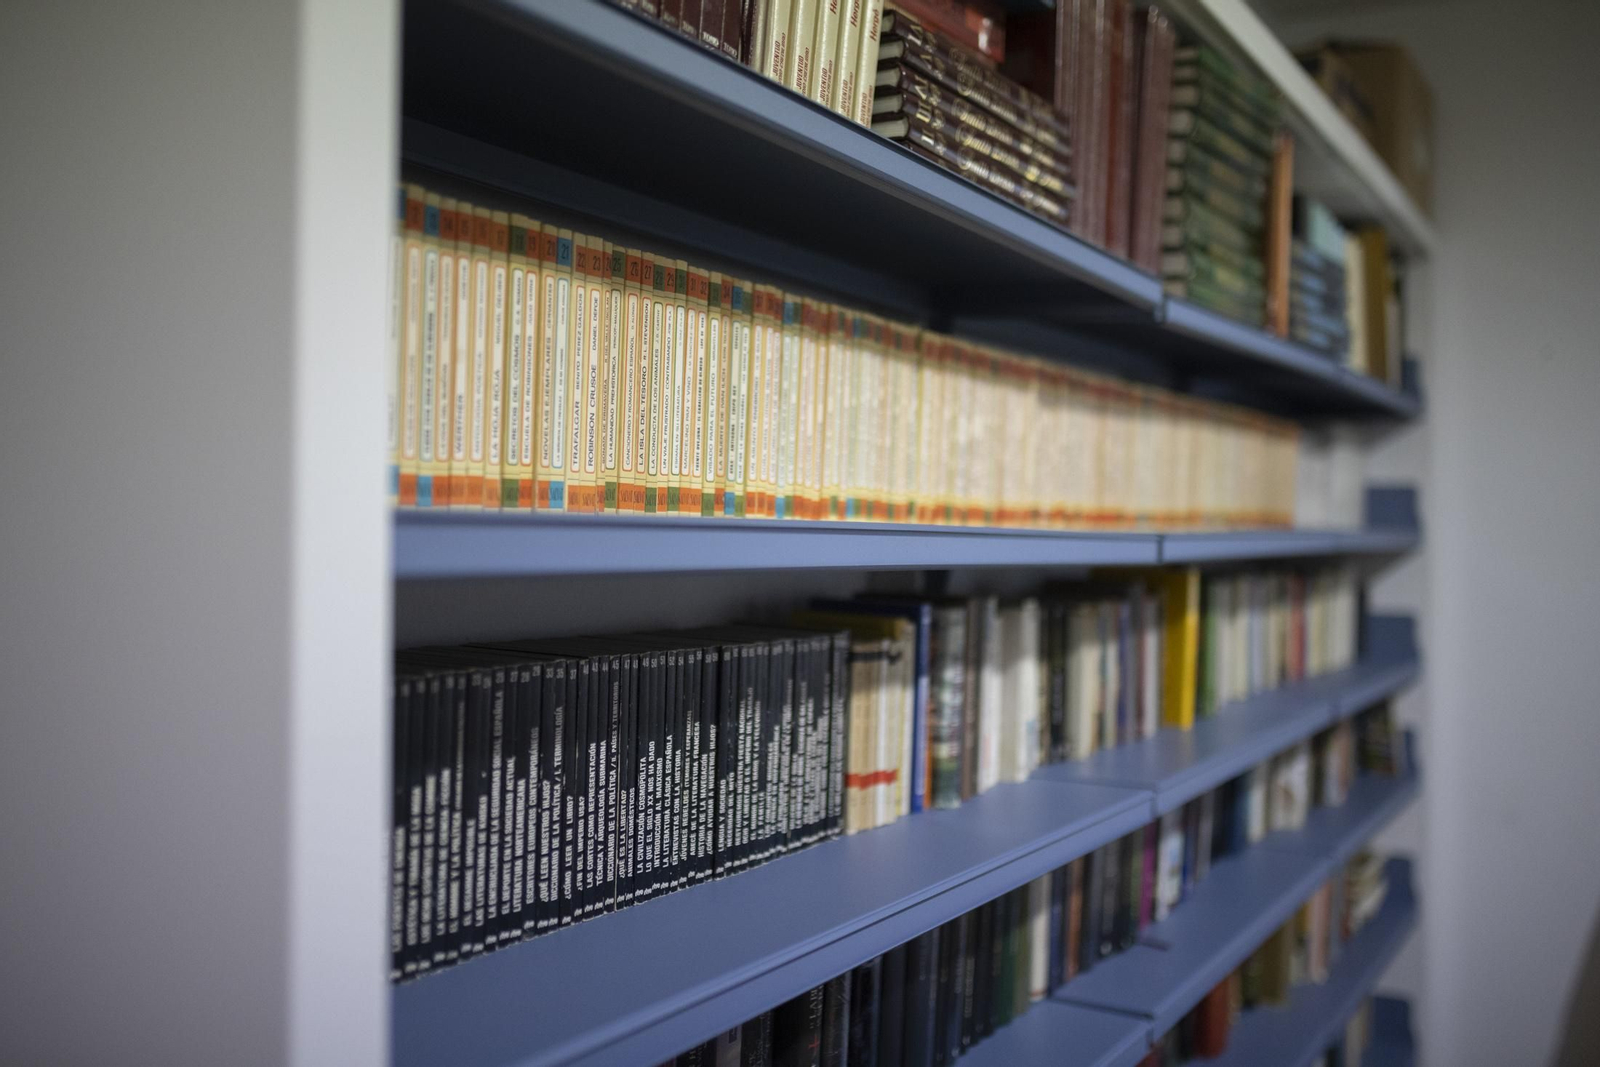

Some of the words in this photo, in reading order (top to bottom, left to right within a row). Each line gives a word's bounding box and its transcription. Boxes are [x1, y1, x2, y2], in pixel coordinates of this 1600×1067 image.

[664, 337, 672, 390] CONTRABANDO
[589, 364, 597, 408] CRUSOE
[664, 734, 673, 774] ESPAÑOLA
[692, 721, 700, 759] FRANCESA
[587, 742, 597, 812] REPRESENTACIÓN
[598, 740, 607, 786] SUBMARINA
[647, 763, 655, 775] HA
[674, 749, 682, 784] HISTORIA
[638, 756, 647, 811] COSMOPOLITA
[647, 776, 655, 792] NOS
[655, 757, 664, 799] MARXISMO
[663, 775, 672, 807] CLÁSICA
[673, 785, 681, 796] LA
[690, 760, 699, 807] LITERATURA
[540, 780, 551, 809] HIJOS?
[551, 784, 562, 821] POLÍTICA
[577, 795, 586, 817] USA?
[647, 794, 654, 806] XX
[655, 800, 663, 811] AL
[699, 799, 707, 811] LA
[719, 779, 727, 814] SOCIEDAD
[514, 778, 526, 857] NORTEAMERICANA
[565, 795, 574, 824] LIBRO?
[619, 790, 627, 831] LIBERTAD?
[646, 808, 654, 831] SIGLO
[690, 807, 698, 819] LA
[699, 812, 706, 823] DE
[707, 799, 715, 828] AYUDAR
[527, 807, 538, 851] EUROPEOS
[540, 810, 550, 855] NUESTROS
[551, 823, 561, 835] LA
[565, 829, 573, 841] UN
[577, 819, 585, 853] IMPERIO
[587, 814, 595, 838] COMO
[619, 833, 627, 845] LA
[636, 812, 646, 861] CIVILIZACIÓN
[646, 832, 653, 843] EL
[690, 820, 697, 831] DE
[718, 824, 726, 852] LENGUA
[502, 848, 513, 861] EN
[503, 835, 513, 847] LA
[551, 836, 561, 849] DE
[587, 839, 595, 870] CORTES
[618, 846, 627, 857] ES
[645, 844, 653, 861] QUE
[653, 813, 662, 868] INTRODUCCIÓN
[672, 815, 680, 866] ENTREVISTAS
[697, 824, 706, 858] HISTORIA
[539, 857, 550, 879] LEEN
[564, 845, 573, 867] LEER
[576, 854, 584, 870] DEL
[595, 851, 605, 886] TÉCNICA
[636, 862, 644, 874] LA
[645, 861, 653, 873] LO
[662, 856, 670, 868] LA
[513, 859, 524, 913] LITERATURA
[525, 852, 537, 904] ESCRITORES
[550, 850, 560, 901] DICCIONARIO
[563, 870, 572, 900] ¿CÓMO
[586, 872, 594, 889] LAS
[501, 902, 511, 915] EL
